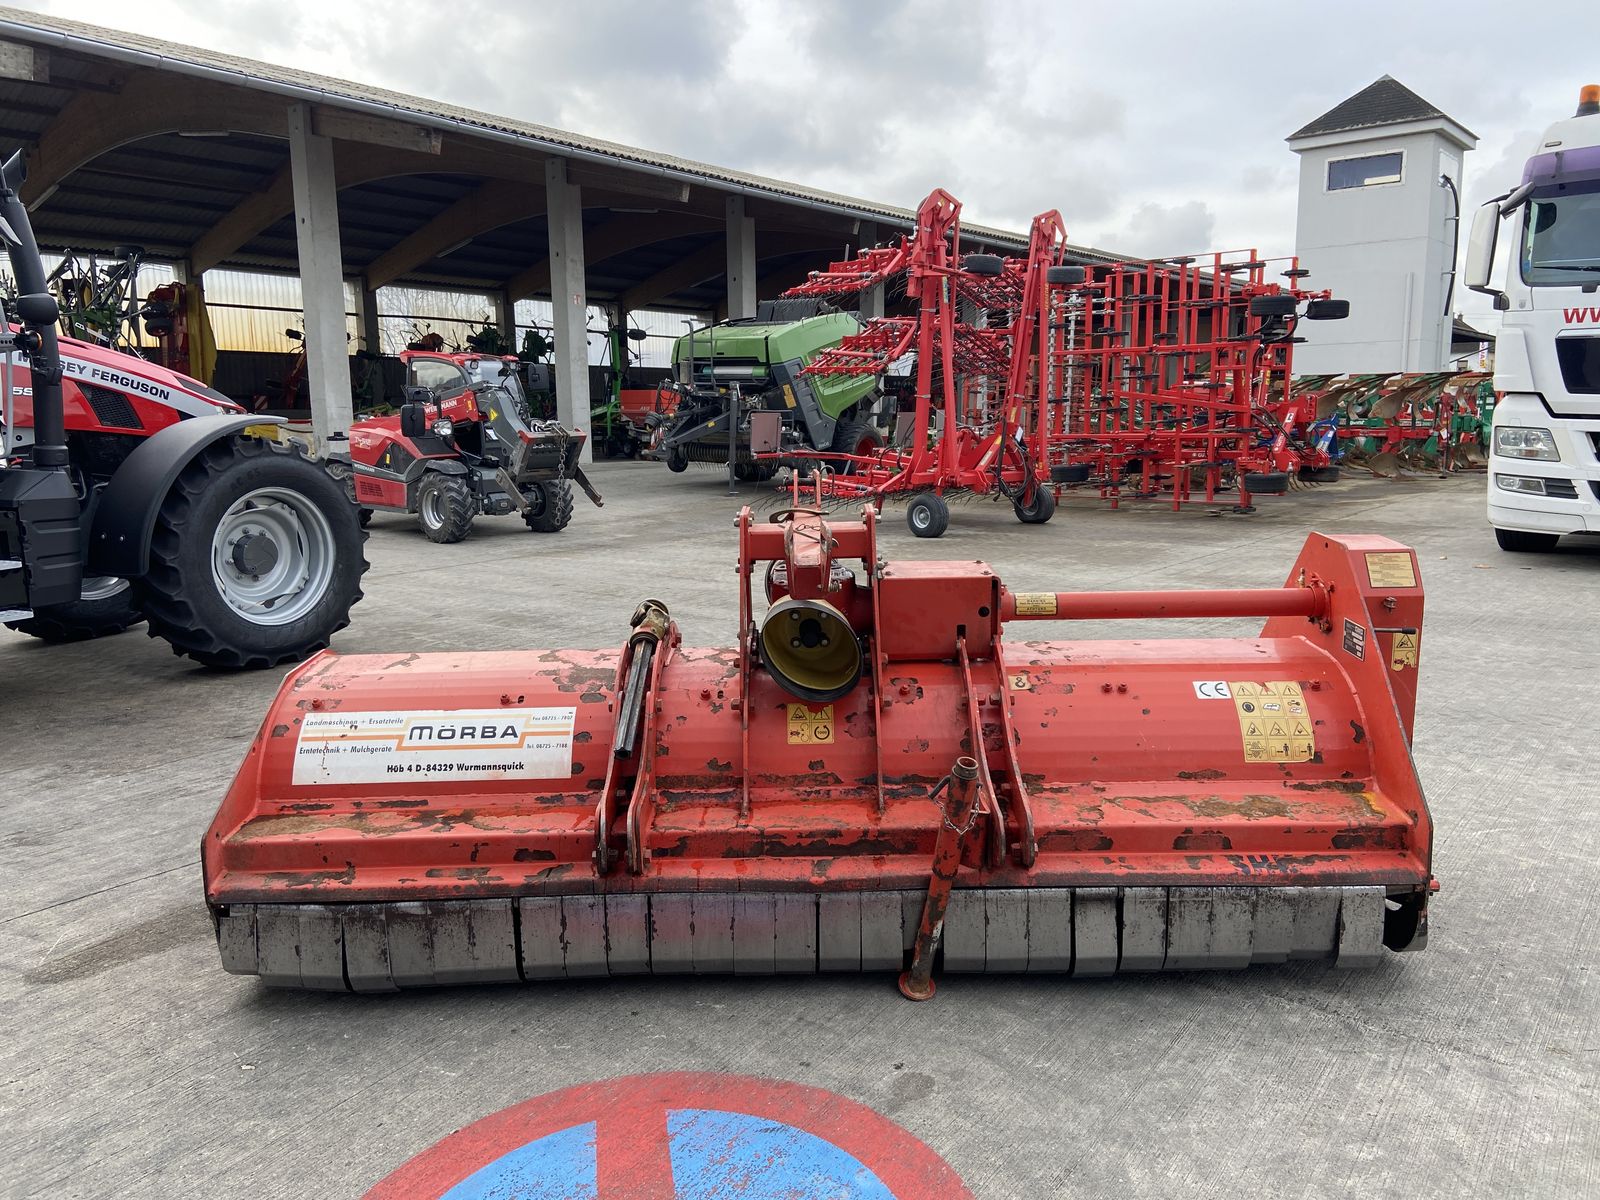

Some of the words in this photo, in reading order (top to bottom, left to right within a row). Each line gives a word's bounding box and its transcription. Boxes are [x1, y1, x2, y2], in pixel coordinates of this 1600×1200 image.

[91, 368, 170, 400] FERGUSON
[1199, 682, 1228, 697] CE
[306, 718, 358, 727] Landmaschinen
[368, 717, 404, 726] Ersatzteile
[409, 725, 519, 740] MÖRBA
[299, 746, 340, 755] Erntetechnik
[407, 763, 413, 772] 4
[415, 763, 454, 772] D-84329
[456, 761, 525, 773] Wurmannsquick
